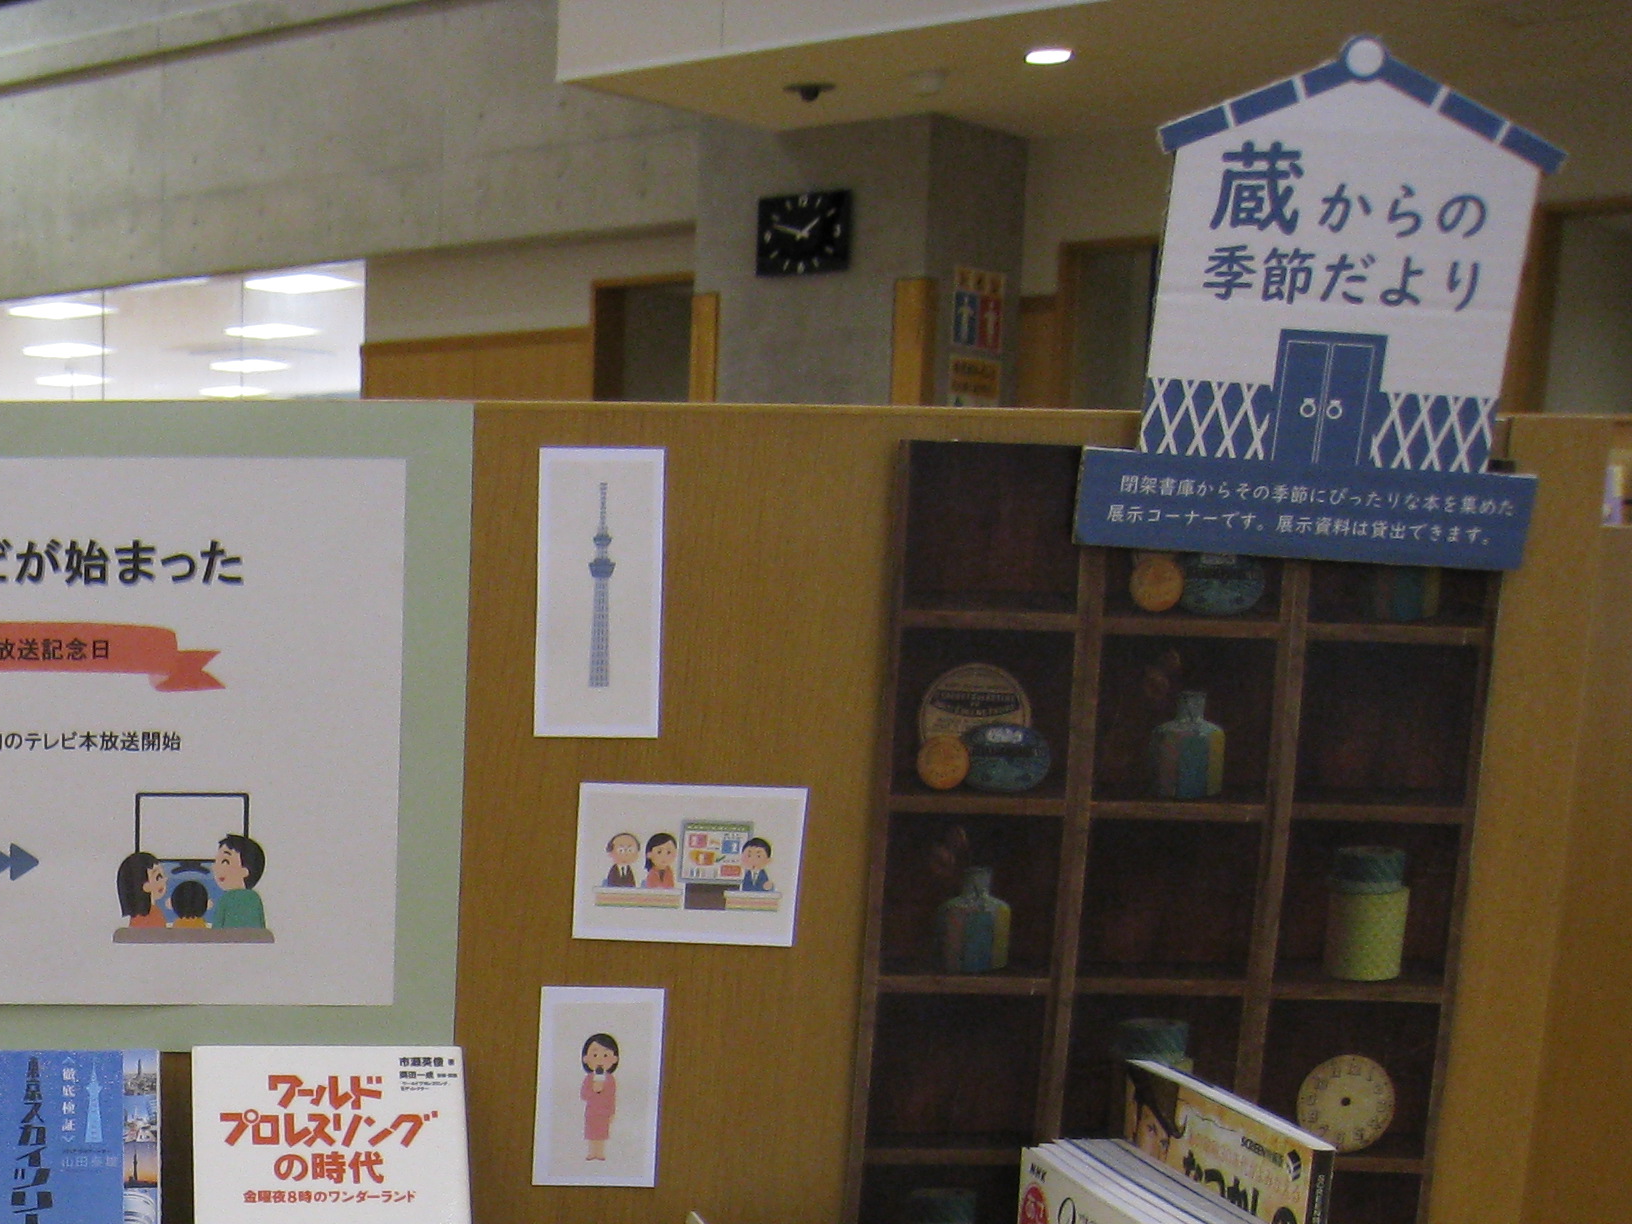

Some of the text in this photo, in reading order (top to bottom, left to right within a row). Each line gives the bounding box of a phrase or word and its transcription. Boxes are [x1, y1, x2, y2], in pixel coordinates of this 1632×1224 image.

[1210, 141, 1489, 239] 蔵からの
[1202, 244, 1481, 313] 季節だより
[1119, 474, 1516, 519] 閉架書庫からその季節にぴったりな本を集めた
[267, 1074, 383, 1111] ワールド
[219, 1108, 439, 1149] プロレスリング
[273, 1150, 385, 1185] の時代
[243, 1189, 417, 1205] 金曜夜8時のワンダーランド
